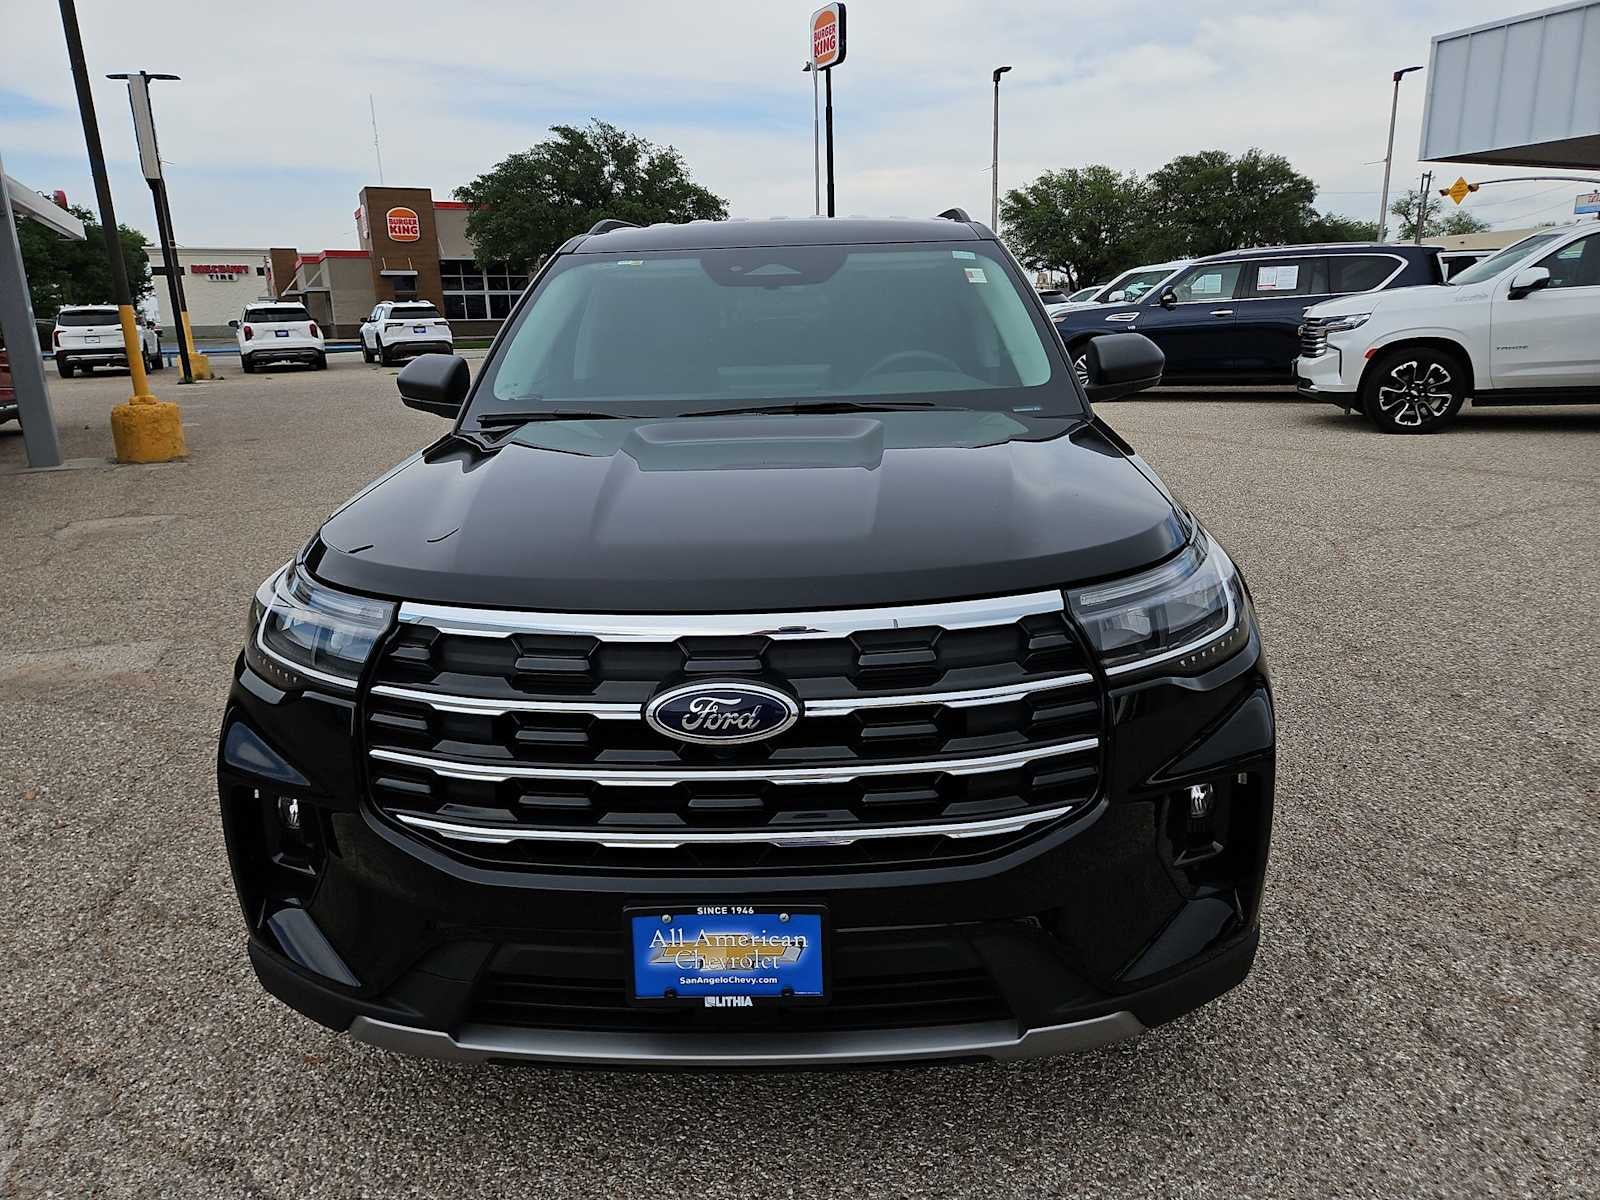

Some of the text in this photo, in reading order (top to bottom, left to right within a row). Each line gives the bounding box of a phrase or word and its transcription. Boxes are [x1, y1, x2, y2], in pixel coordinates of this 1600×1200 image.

[814, 23, 836, 42] BURGER
[814, 35, 836, 58] KING
[390, 226, 418, 235] KING
[681, 697, 763, 731] Ford
[697, 906, 755, 915] SINCE 1946
[649, 928, 808, 948] All American
[675, 949, 781, 970] Chevrolet
[679, 976, 778, 985] SanAngeloChevy.com
[714, 996, 753, 1008] LITHIA
